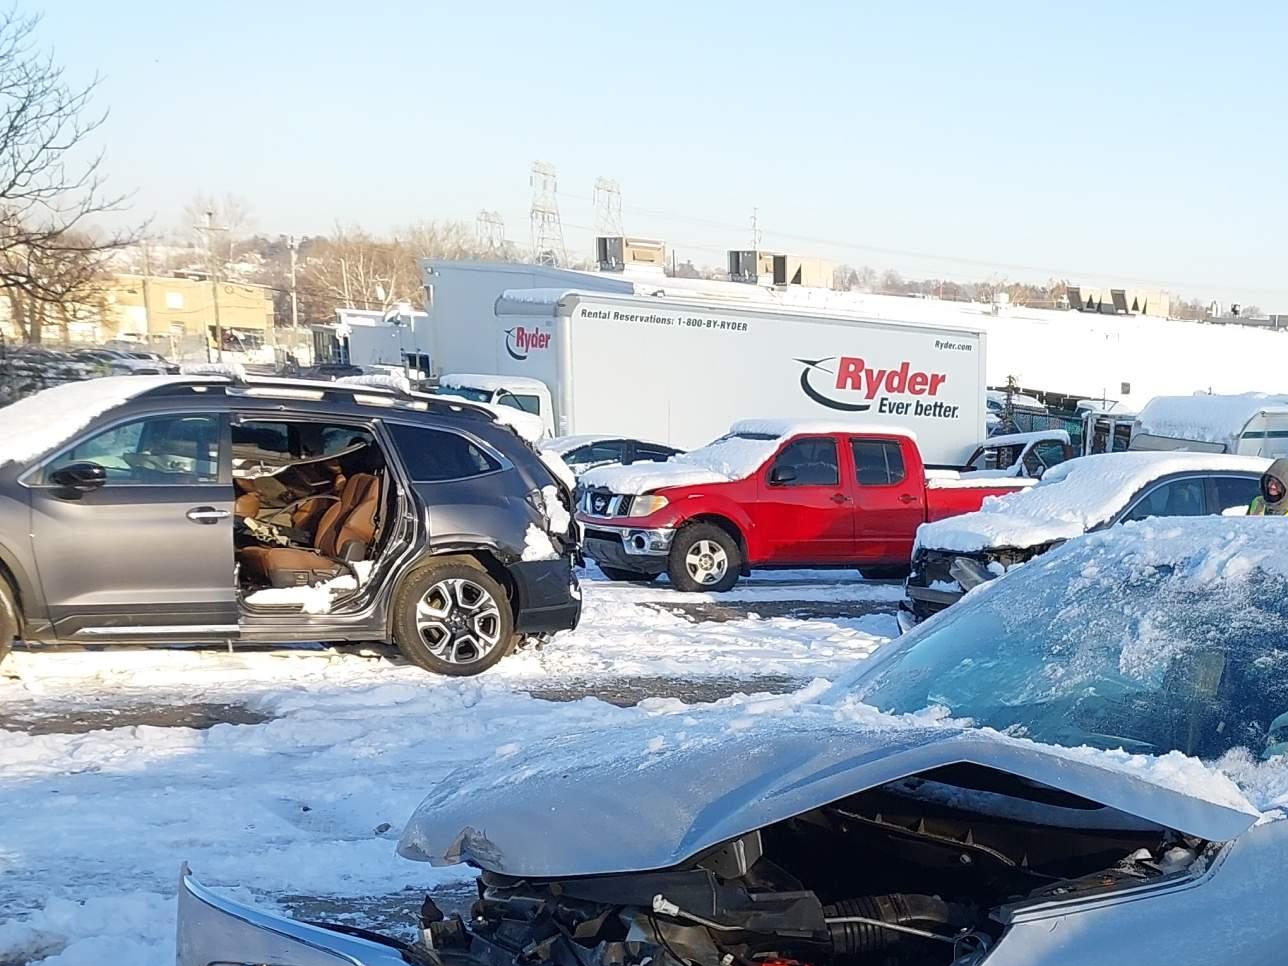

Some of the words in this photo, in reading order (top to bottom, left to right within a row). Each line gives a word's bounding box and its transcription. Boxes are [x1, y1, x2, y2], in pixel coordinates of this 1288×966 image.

[581, 309, 610, 320] Rental
[613, 311, 674, 325] Reservations:
[677, 317, 748, 331] 1-800-BY-RYDER
[516, 326, 551, 353] Ryder
[935, 340, 972, 351] Ryder.com
[835, 356, 946, 400] Ryder
[878, 397, 912, 416] Ever
[914, 400, 959, 419] better.
